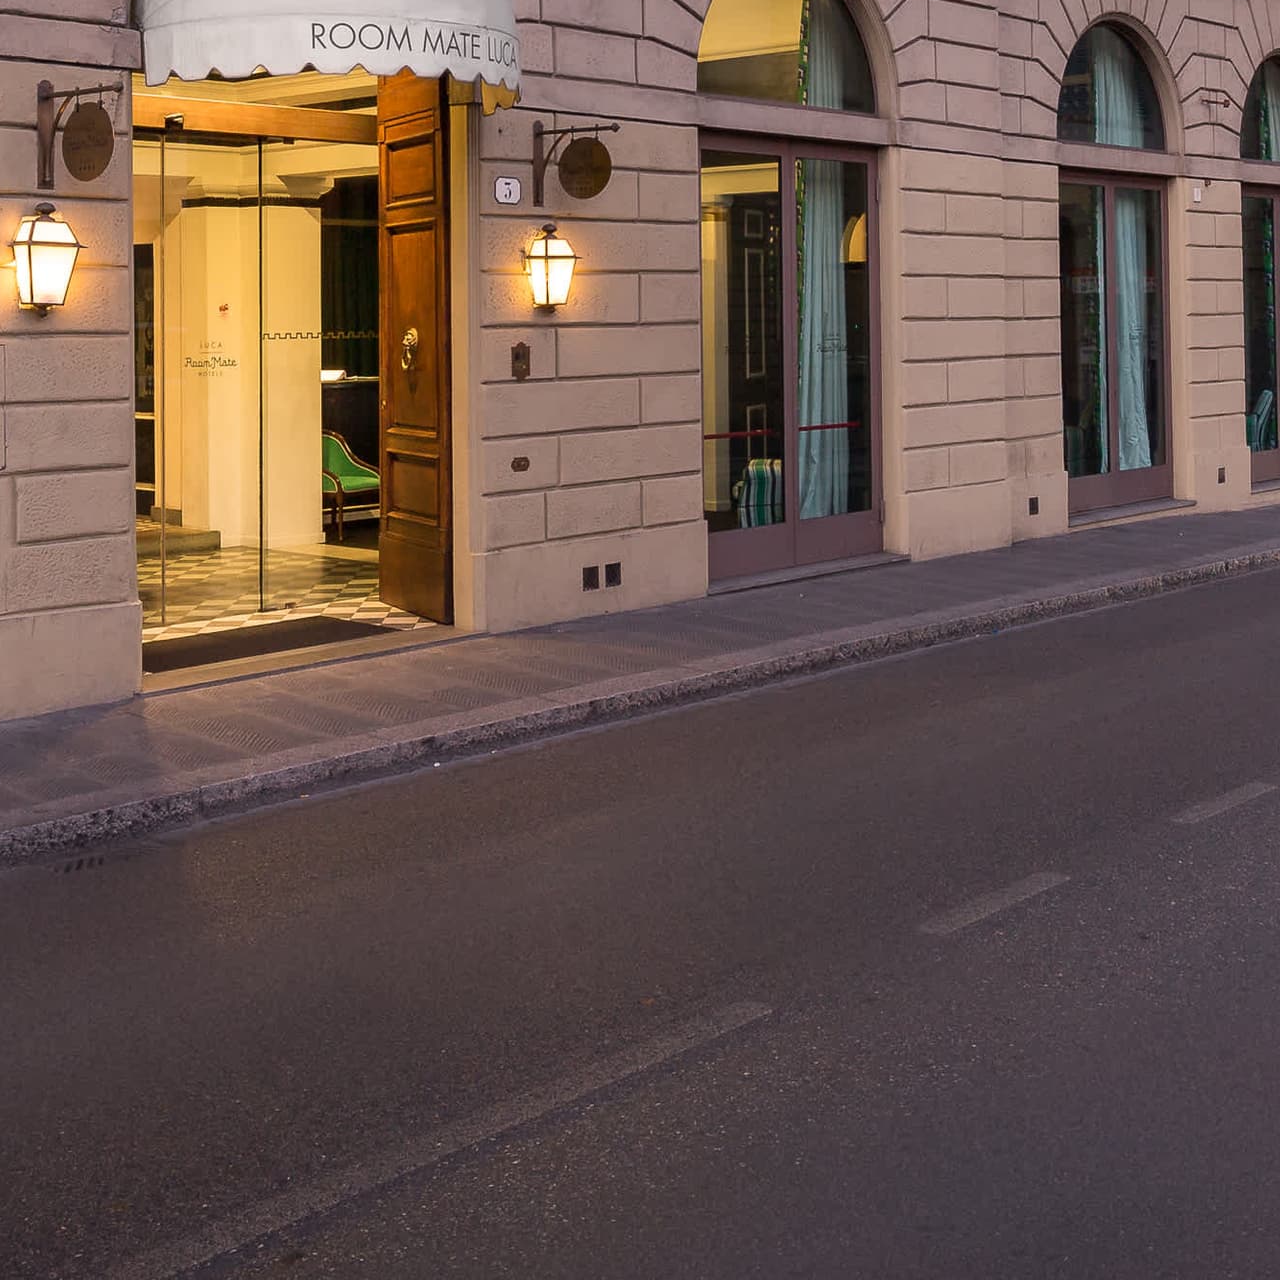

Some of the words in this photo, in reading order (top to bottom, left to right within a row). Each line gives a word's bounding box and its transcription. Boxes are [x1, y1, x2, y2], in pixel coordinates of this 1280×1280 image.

[310, 22, 413, 52] ROOM
[422, 27, 481, 60] MATE
[487, 36, 518, 70] LUCA
